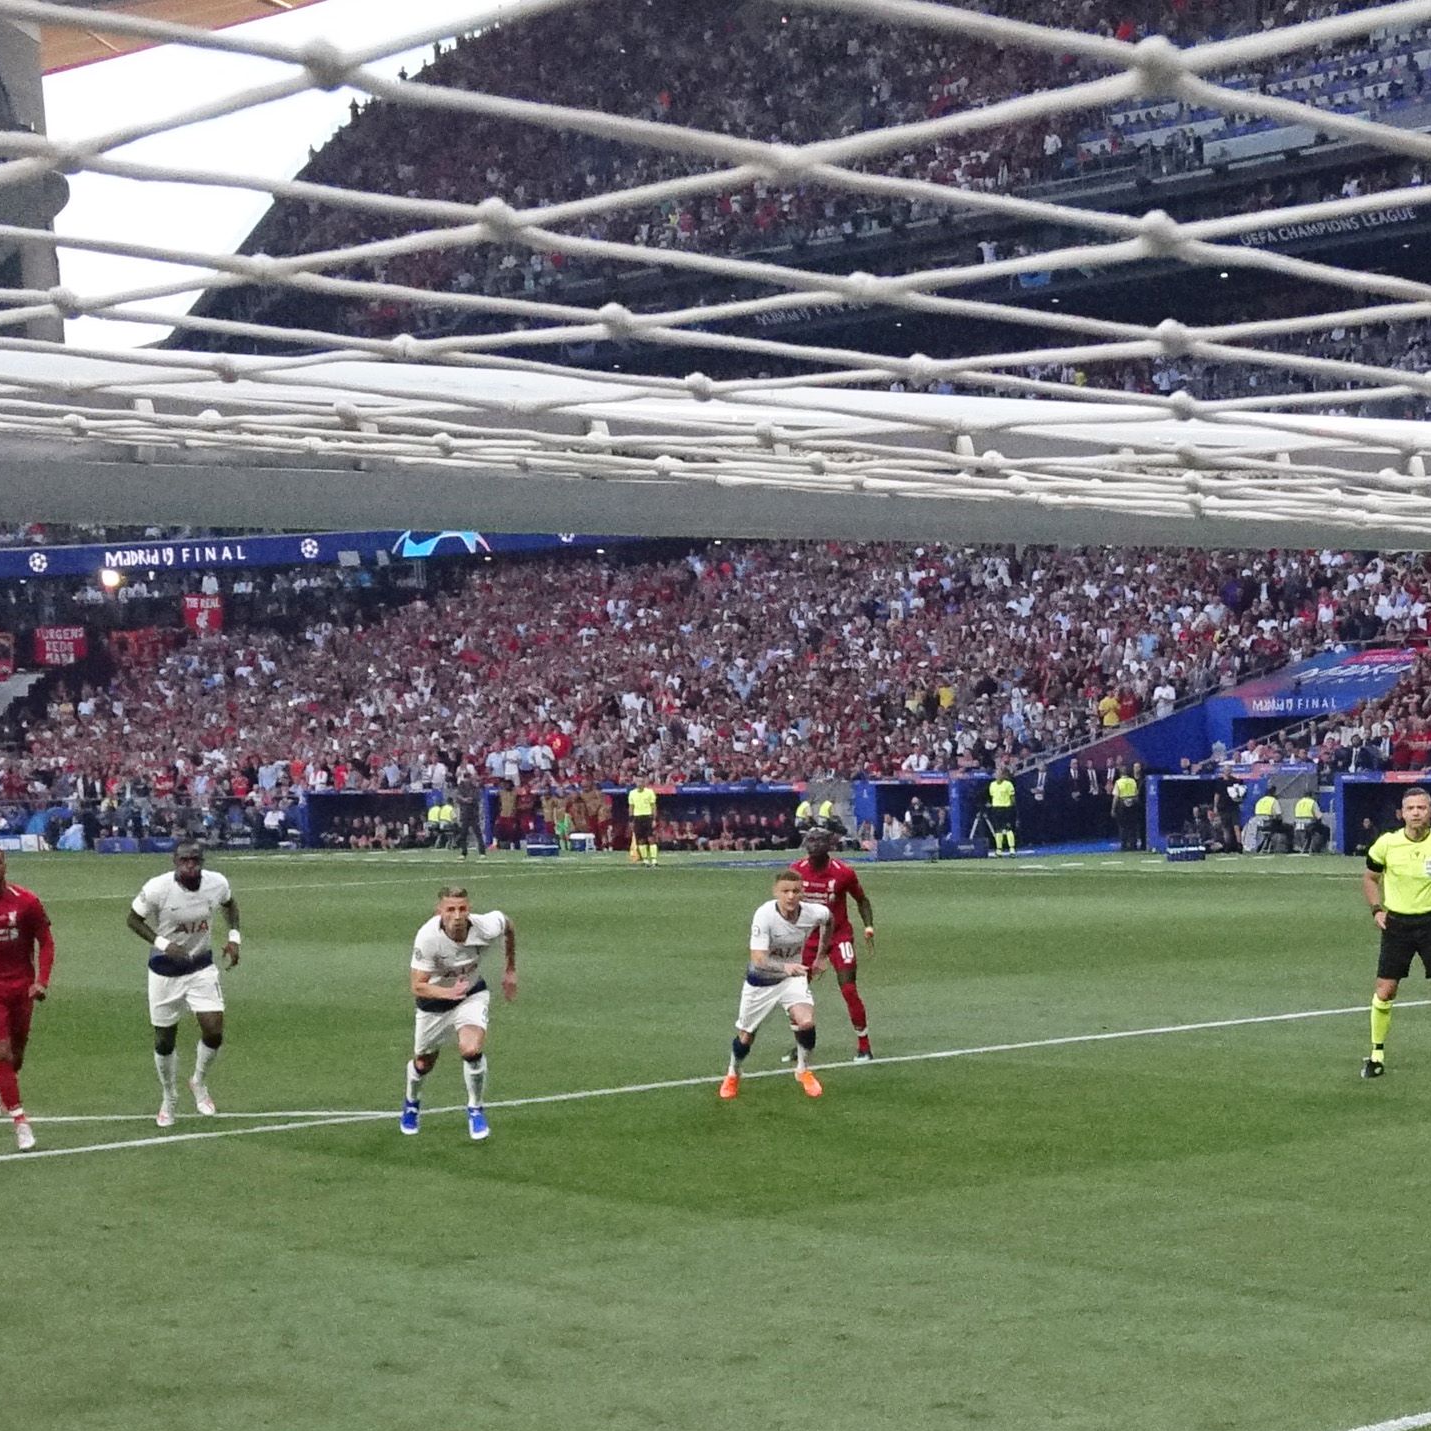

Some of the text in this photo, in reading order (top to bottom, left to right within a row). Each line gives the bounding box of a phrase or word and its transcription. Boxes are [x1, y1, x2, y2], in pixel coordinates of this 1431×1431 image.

[1240, 207, 1417, 247] UEFA CHAMPIONS LEAGUE
[182, 545, 246, 562] FINAL
[1297, 697, 1337, 709] FINAL
[838, 941, 854, 960] 10
